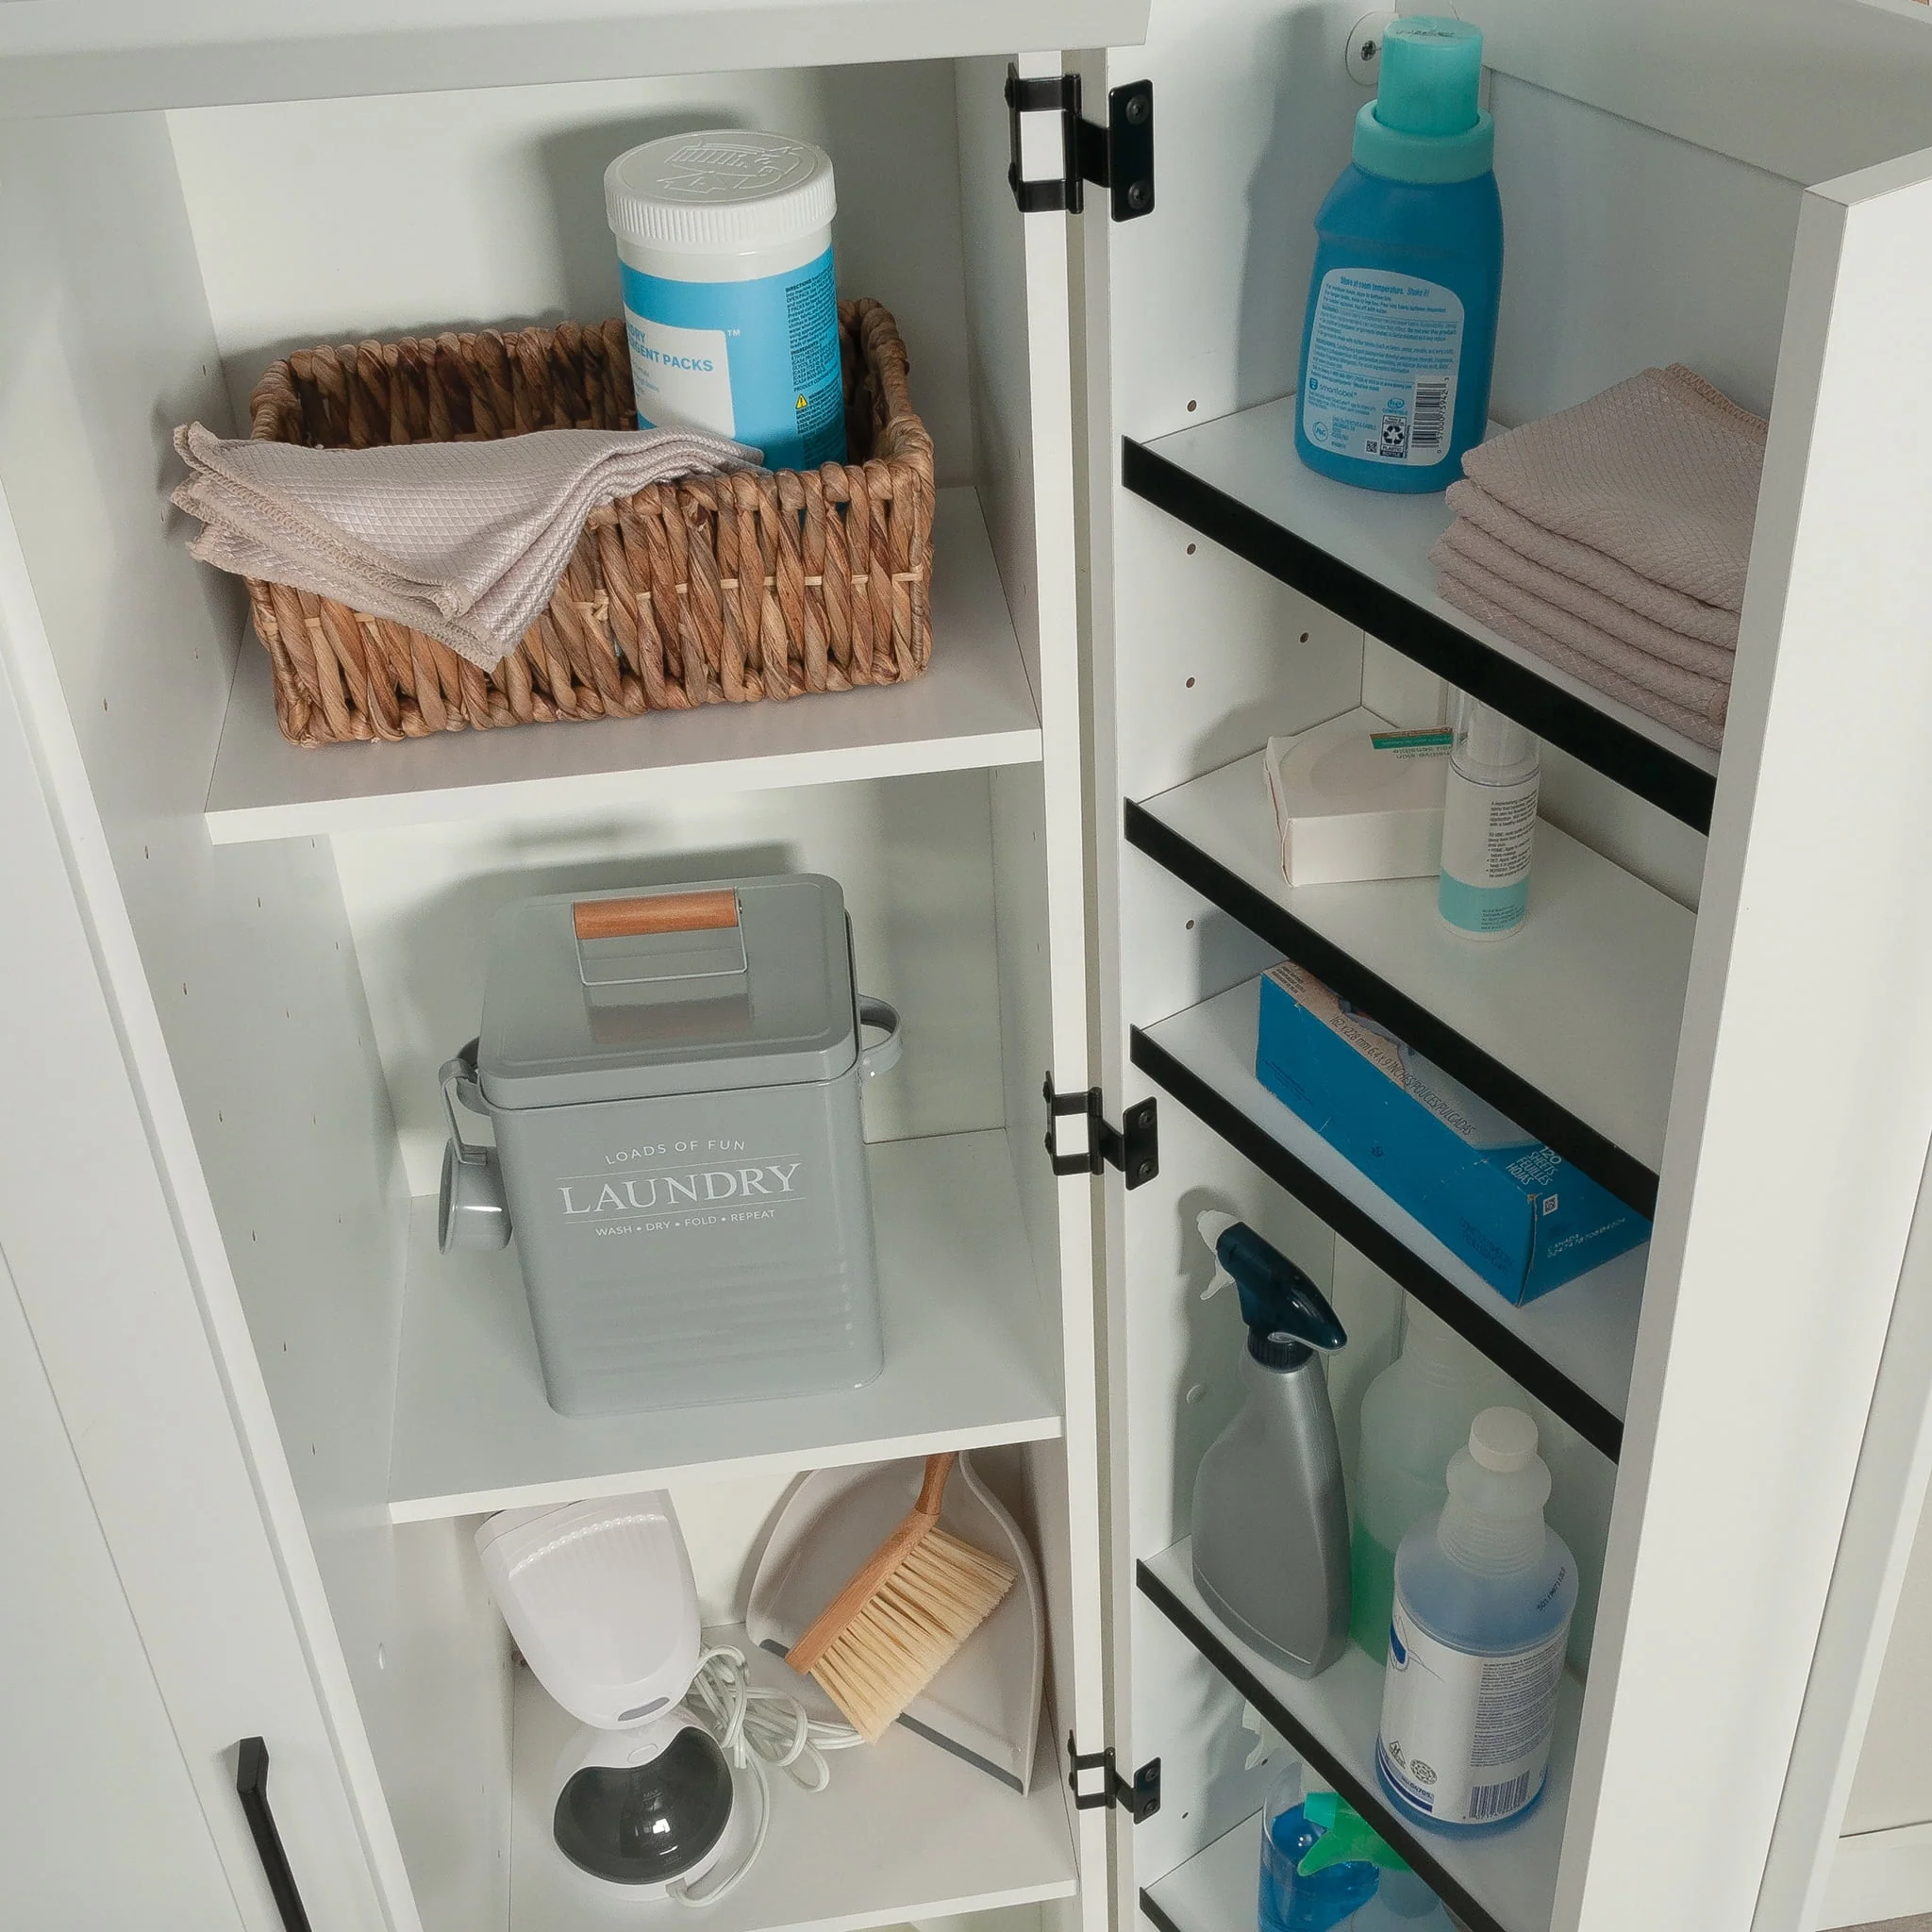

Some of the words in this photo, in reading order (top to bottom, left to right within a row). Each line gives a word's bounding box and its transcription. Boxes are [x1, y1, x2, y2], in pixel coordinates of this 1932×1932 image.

[662, 354, 713, 372] PACKS
[1342, 1026, 1361, 1042] 228
[606, 1143, 666, 1165] LOADS
[675, 1141, 699, 1152] OF
[708, 1140, 745, 1151] FUN
[1526, 1151, 1558, 1175] SHEETS
[1539, 1145, 1561, 1164] 120
[1505, 1162, 1534, 1185] HOJAS
[1516, 1157, 1553, 1185] FEUILLES
[558, 1162, 801, 1215] LAUNDRY
[595, 1224, 632, 1236] WASH
[646, 1221, 672, 1232] DRY
[685, 1216, 717, 1227] FOLD
[731, 1209, 775, 1223] REPEAT
[1548, 1234, 1579, 1252] CANADA
